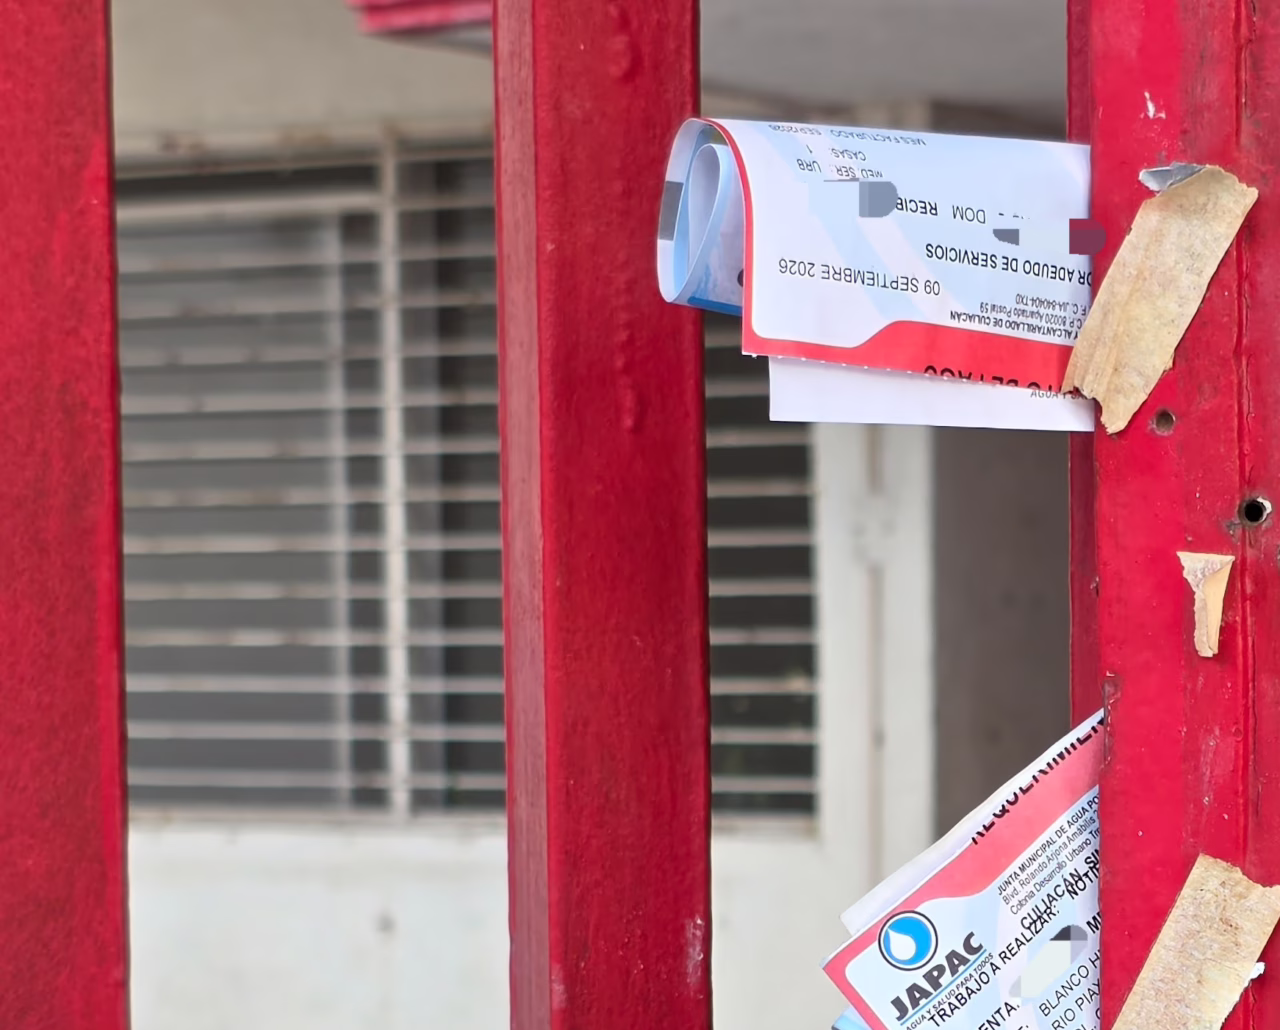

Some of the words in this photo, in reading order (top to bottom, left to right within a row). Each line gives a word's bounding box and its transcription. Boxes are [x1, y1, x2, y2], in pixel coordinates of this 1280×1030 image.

[796, 158, 822, 173] URB
[952, 205, 986, 224] DOM
[778, 257, 815, 277] 2026
[925, 243, 998, 269] SERVICIOS
[1002, 256, 1018, 272] DE
[821, 264, 919, 293] SEPTIEMBRE
[1023, 260, 1075, 283] ADEUDO
[924, 279, 940, 296] 09
[980, 302, 989, 313] 59
[990, 302, 1012, 318] Postal
[992, 317, 1003, 328] DE
[1005, 319, 1075, 340] ALCANTARILLADO
[998, 871, 1020, 896] JUNTA
[1018, 837, 1057, 873] MUNICIPAL
[1054, 825, 1068, 839] DE
[1067, 806, 1089, 829] AGUA
[1002, 887, 1021, 905] Blvd.
[1018, 861, 1048, 889] Rolando
[1047, 841, 1068, 864] Arjona
[1010, 890, 1036, 915] Colonia
[1065, 837, 1092, 863] Urbano
[890, 931, 984, 1022] JAPAC
[928, 971, 990, 1027] TRABAJO
[989, 962, 1001, 976] A
[998, 904, 1060, 964] REALIZAR:
[932, 989, 956, 1011] SALUD
[955, 973, 974, 991] PARA
[973, 952, 994, 975] TODOS
[1039, 965, 1089, 1017] BLANCO
